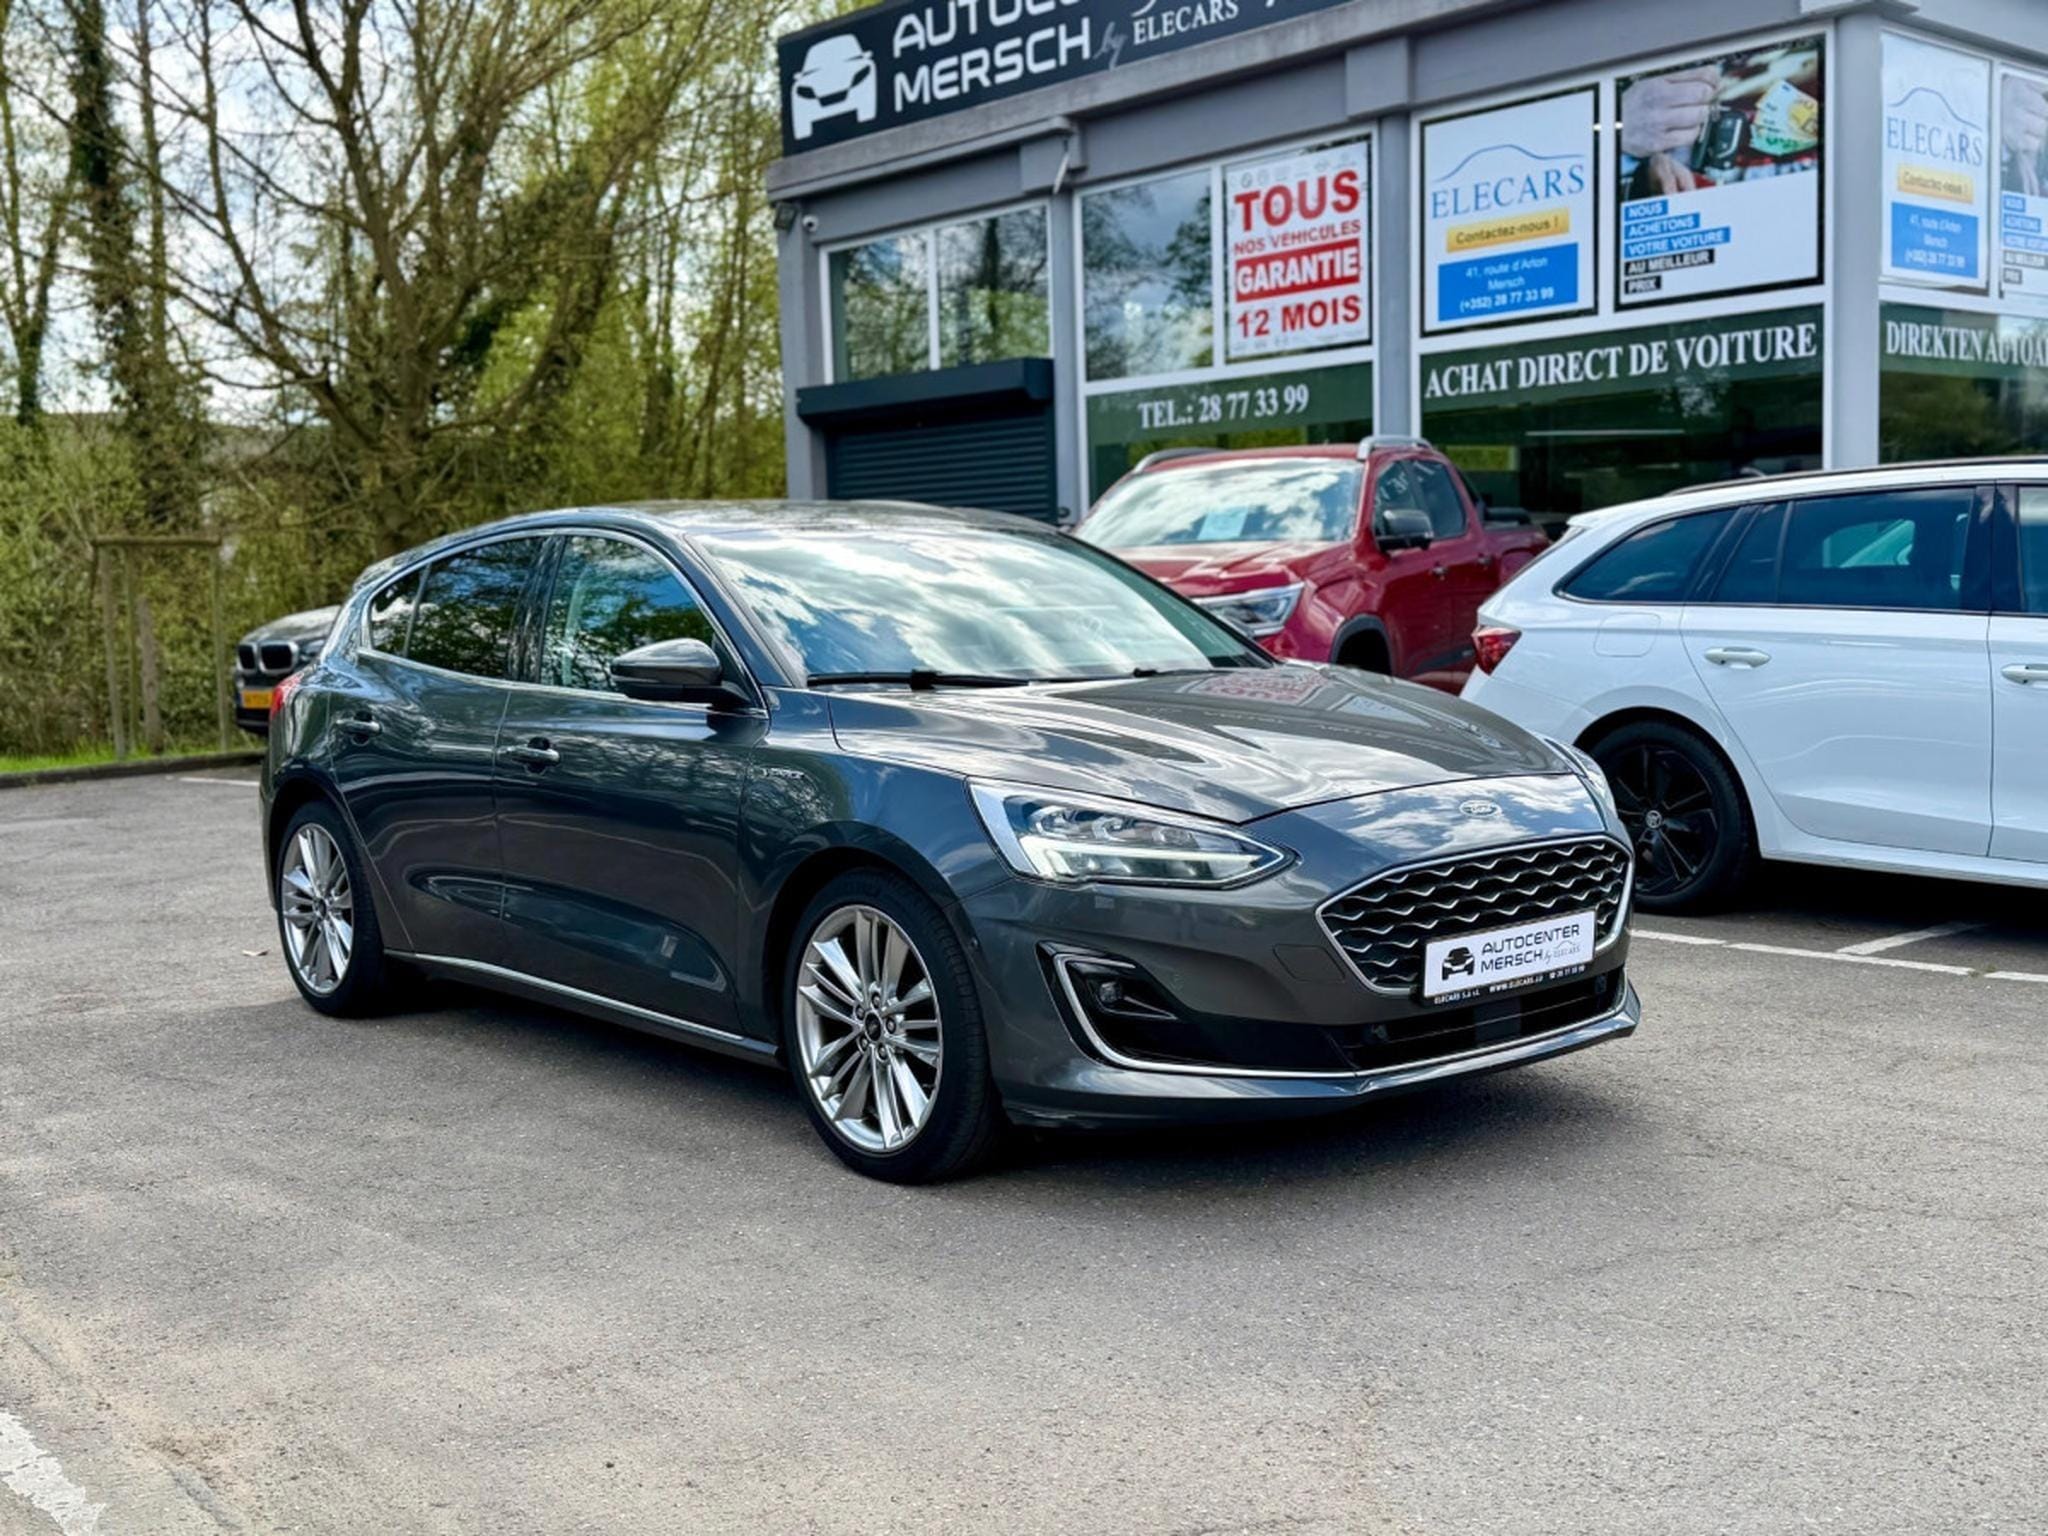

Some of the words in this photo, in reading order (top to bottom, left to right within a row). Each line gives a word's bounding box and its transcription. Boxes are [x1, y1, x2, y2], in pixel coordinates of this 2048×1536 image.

[894, 17, 1090, 112] MERSCH
[1133, 0, 1239, 45] ELECARS
[1886, 117, 1983, 167] ELECARS
[1234, 169, 1360, 232] TOUS
[1431, 164, 1585, 219] ELECARS
[1628, 202, 1662, 218] NOUS
[1234, 238, 1265, 256] NOS
[1269, 219, 1361, 249] VEHICULES
[1455, 219, 1550, 245] Contactez-nous
[1628, 239, 1669, 256] VOTRE
[1671, 230, 1725, 249] VOITURE
[1629, 216, 1695, 237] ACHETONS
[1236, 246, 1359, 294] GARANTIE
[1629, 259, 1646, 274] AU
[1647, 249, 1709, 272] MEILLEUR
[1237, 309, 1270, 338] 12
[1282, 294, 1361, 332] MOIS
[1424, 358, 1513, 398] ACHAT
[1518, 346, 1623, 389] DIRECT
[1629, 341, 1669, 377] DE
[1675, 322, 1817, 371] VOITURE
[1886, 320, 1984, 361] DIREKTEN
[1137, 400, 1194, 429] TEL.:
[1198, 394, 1222, 423] 28
[1226, 391, 1249, 420] 77
[1254, 387, 1278, 417] 33
[1283, 383, 1310, 414] 99
[1481, 924, 1580, 955] AUTOCENTER
[1480, 950, 1543, 973] MERSCH
